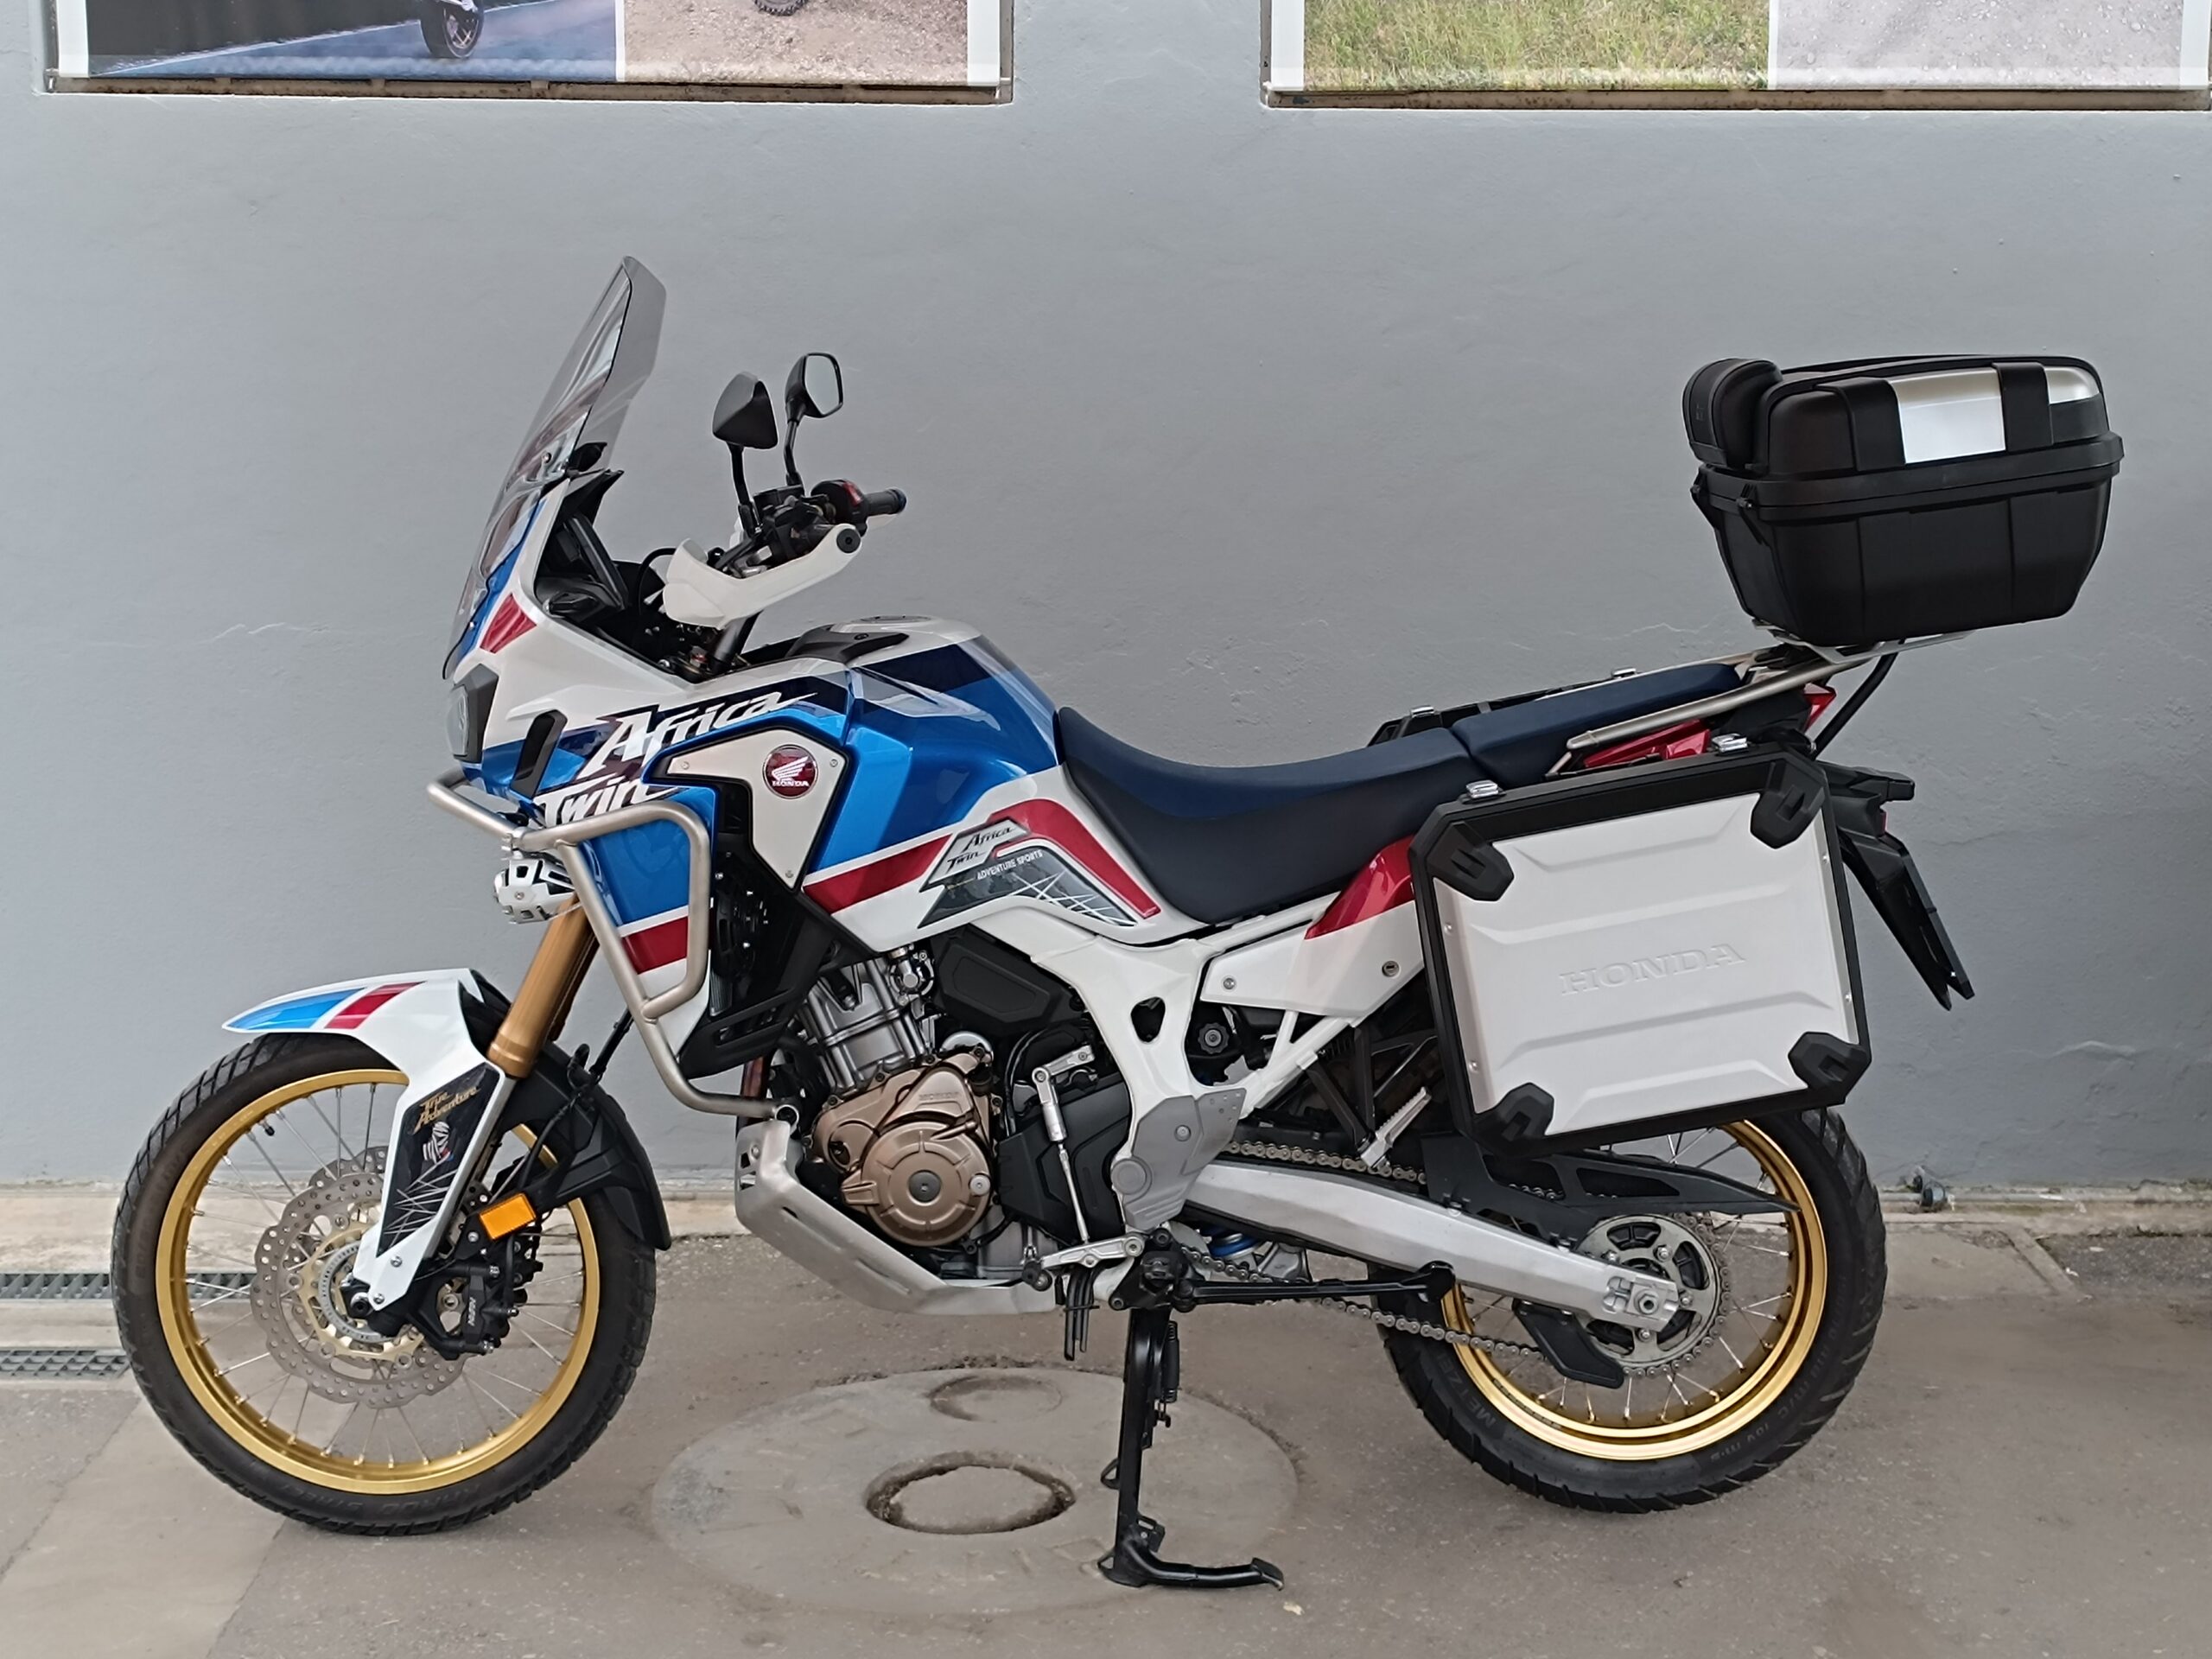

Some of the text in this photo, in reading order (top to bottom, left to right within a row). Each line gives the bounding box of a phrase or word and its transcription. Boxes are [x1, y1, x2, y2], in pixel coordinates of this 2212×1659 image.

[575, 691, 818, 779] Africa
[532, 772, 680, 828] Twin
[961, 826, 1014, 853] Africa
[946, 850, 982, 872] Twin
[976, 849, 1043, 880] ADVENTURE SPORTS
[1558, 943, 1746, 995] HONDA
[413, 1086, 480, 1135] Adventure
[420, 1091, 452, 1111] True
